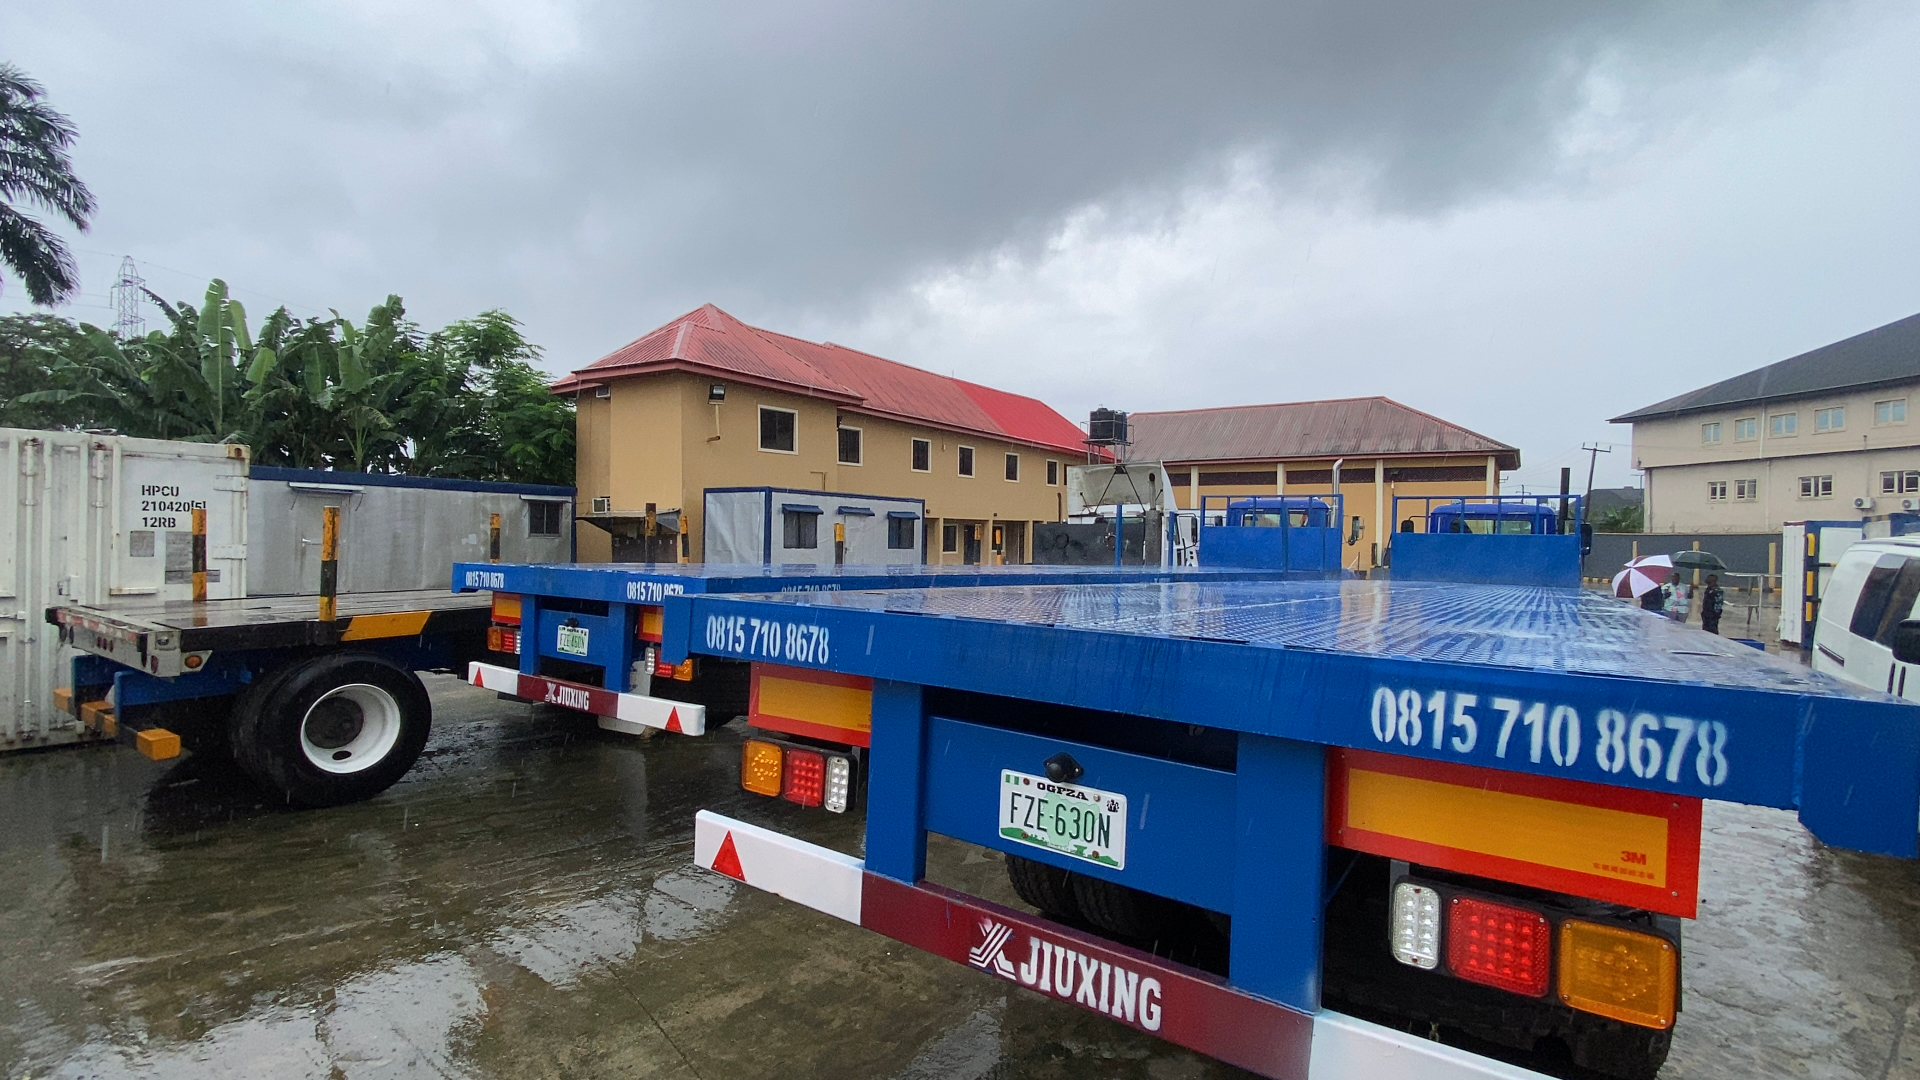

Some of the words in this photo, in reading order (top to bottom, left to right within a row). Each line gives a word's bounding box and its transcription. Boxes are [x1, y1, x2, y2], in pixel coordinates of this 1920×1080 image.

[141, 485, 180, 497] HPCU
[142, 516, 177, 528] 12RB
[479, 571, 490, 588] 710
[627, 581, 646, 601] 0815
[647, 582, 662, 602] 710
[706, 615, 746, 653] 0815
[750, 618, 781, 658] 710
[785, 622, 830, 665] 8678
[557, 685, 590, 711] JIUXING
[1371, 687, 1478, 753] 0815
[1493, 697, 1582, 767] 710
[1595, 709, 1729, 786] 8678
[1010, 791, 1111, 849] FZE-630N
[1620, 850, 1647, 866] 3M
[1020, 936, 1163, 1032] JIUXING
